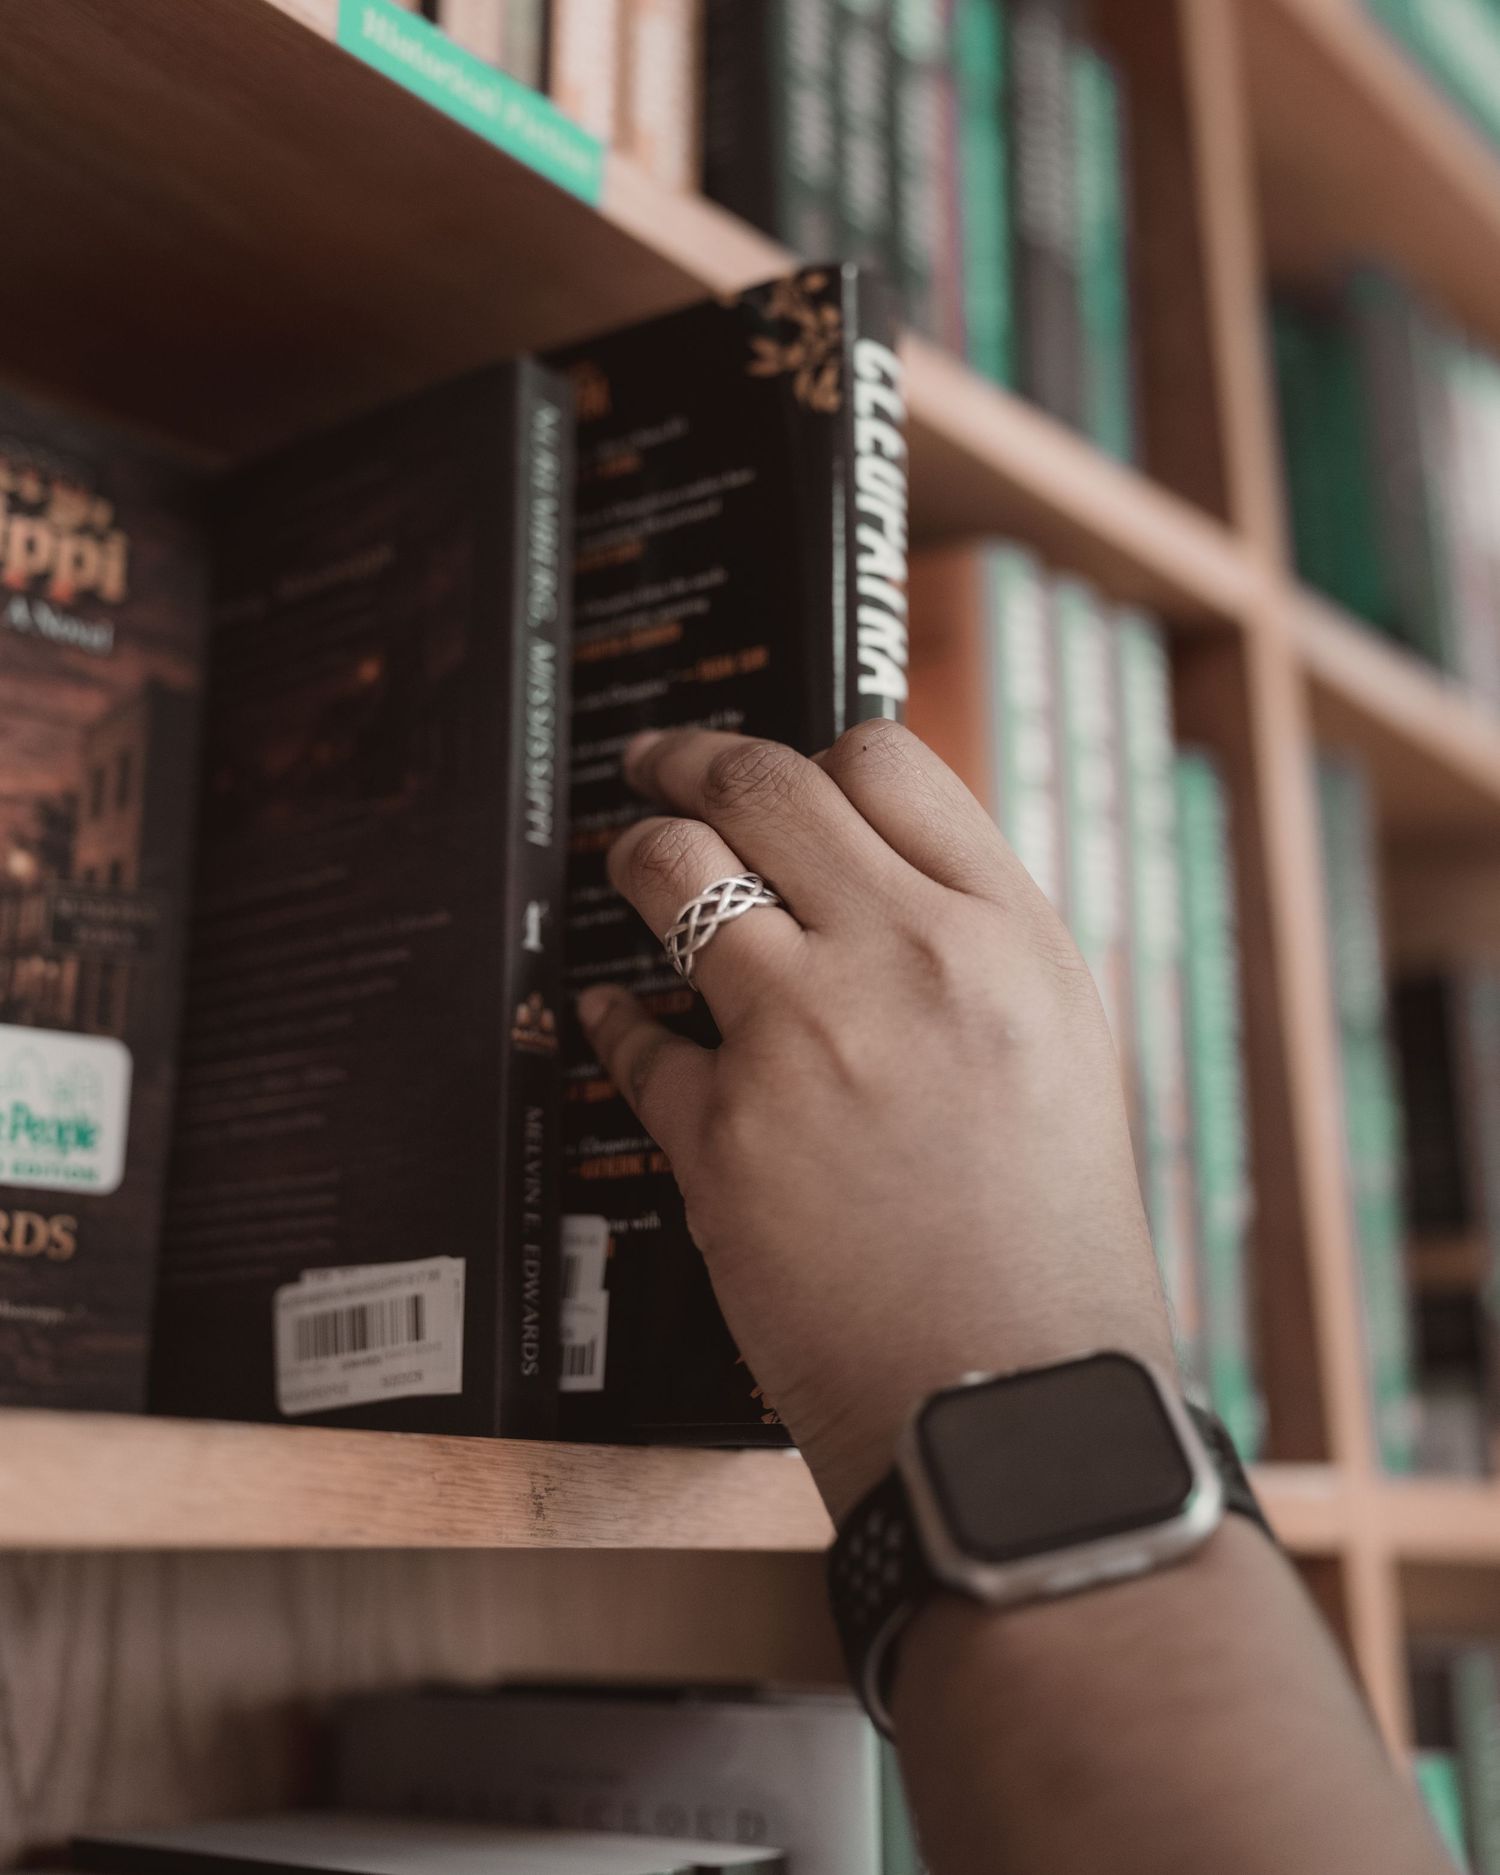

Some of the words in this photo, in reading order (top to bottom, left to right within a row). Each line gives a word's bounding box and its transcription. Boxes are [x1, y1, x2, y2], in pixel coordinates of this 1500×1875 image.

[853, 338, 911, 698] CLEOPATRA
[7, 596, 32, 630] A
[32, 600, 115, 654] Novel
[524, 640, 556, 846] MISSISSIPPI
[11, 1102, 97, 1153] People
[523, 1105, 544, 1205] MELVIN
[12, 1159, 98, 1181] EDITION
[522, 1212, 543, 1232] E.
[521, 1244, 542, 1376] EDWARDS
